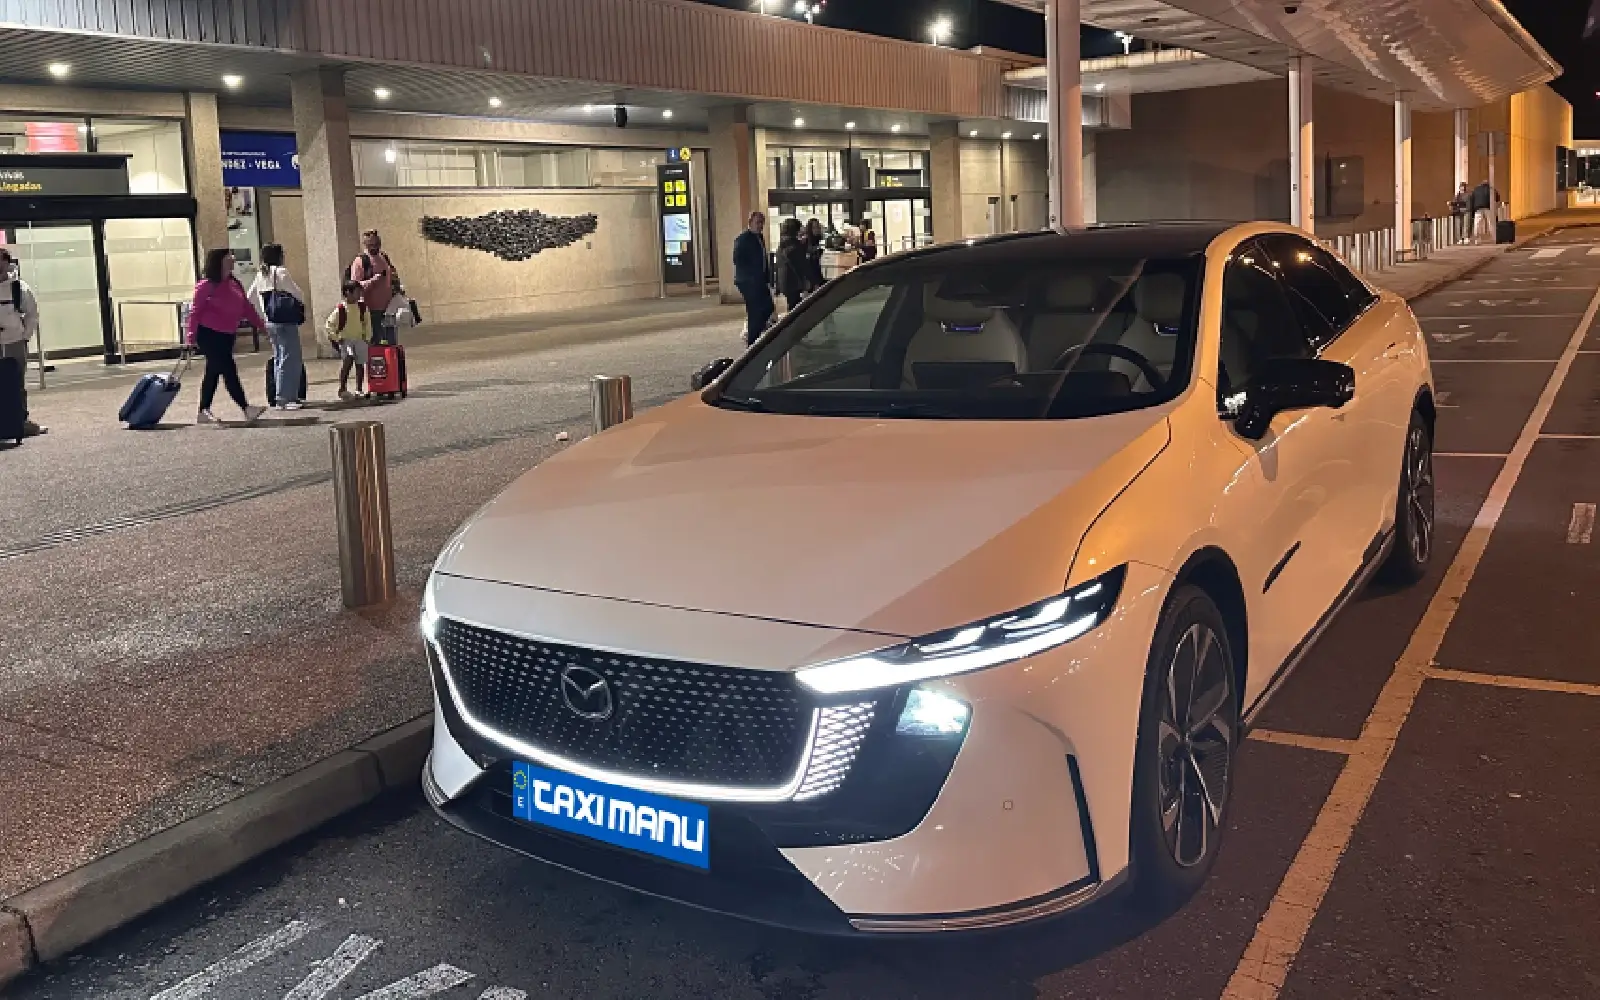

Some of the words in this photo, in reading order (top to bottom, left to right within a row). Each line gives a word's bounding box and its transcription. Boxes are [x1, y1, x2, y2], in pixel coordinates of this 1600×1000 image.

[254, 159, 282, 169] VEGA
[517, 796, 525, 808] E
[533, 779, 605, 827] TAXI
[608, 798, 705, 853] MANU
